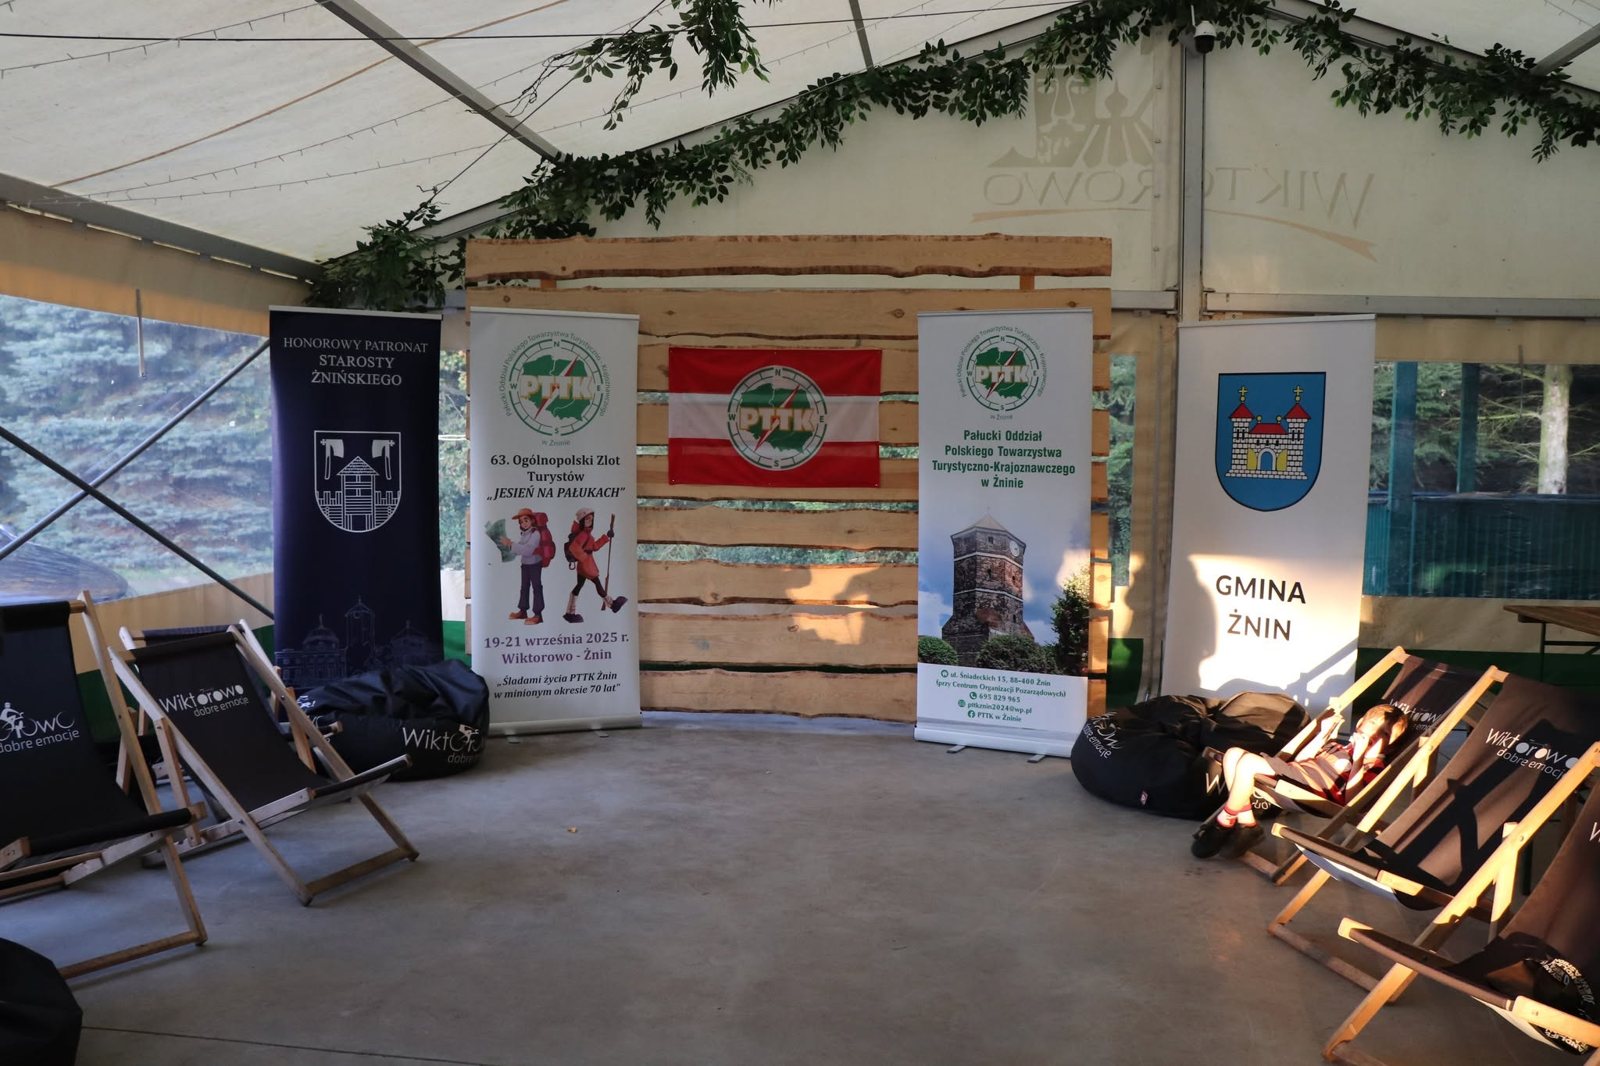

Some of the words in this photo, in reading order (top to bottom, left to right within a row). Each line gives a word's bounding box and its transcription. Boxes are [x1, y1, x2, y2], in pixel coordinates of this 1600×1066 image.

[284, 338, 362, 350] HONOROWY
[365, 340, 428, 352] PATRONAT
[319, 354, 395, 369] STAROSTY
[311, 369, 402, 386] ŻNIŃSKIEGO
[775, 368, 781, 376] N
[975, 365, 1030, 384] PTTK
[520, 375, 594, 400] PTTK
[740, 406, 815, 432] PTTK
[964, 430, 1002, 441] Pałucki
[1005, 430, 1042, 442] Oddział
[945, 445, 994, 458] Polskiego
[998, 446, 1062, 460] Towarzystwa
[490, 454, 510, 466] 63.
[512, 454, 594, 468] Ogólnopolski
[596, 455, 620, 466] Zlot
[932, 460, 1076, 476] Turystyczno-Krajoznawczego
[527, 471, 585, 484] Turystów
[981, 478, 990, 488] w
[993, 474, 1024, 488] Żninie
[486, 485, 534, 500] „JESIEŃ
[537, 487, 554, 498] NA
[1216, 574, 1306, 604] GMINA
[1227, 608, 1291, 641] ŻNIN
[484, 636, 521, 648] 19-21
[525, 634, 583, 646] września
[586, 632, 618, 644] 2025
[620, 634, 630, 642] r.
[502, 652, 573, 664] Wiktorowo
[584, 648, 612, 660] Żnin
[544, 673, 568, 686] życia
[569, 672, 595, 682] PTTK
[597, 670, 618, 681] Żnin
[960, 670, 996, 682] Śniadeckich
[1010, 676, 1035, 686] 88-400
[1036, 678, 1051, 686] Żnin
[504, 688, 552, 699] minionym
[554, 686, 588, 696] okresie
[590, 684, 602, 693] 70
[936, 679, 952, 688] (przy
[952, 681, 978, 690] Centrum
[980, 684, 1014, 694] Organizacji
[158, 684, 244, 713] Wiktorowo
[978, 693, 992, 701] 695
[193, 704, 219, 718] dobre
[220, 696, 249, 711] emocje
[977, 712, 994, 720] PTTK
[1002, 712, 1022, 722] Żninie
[35, 729, 80, 747] emocje
[1496, 748, 1528, 766] dobre
